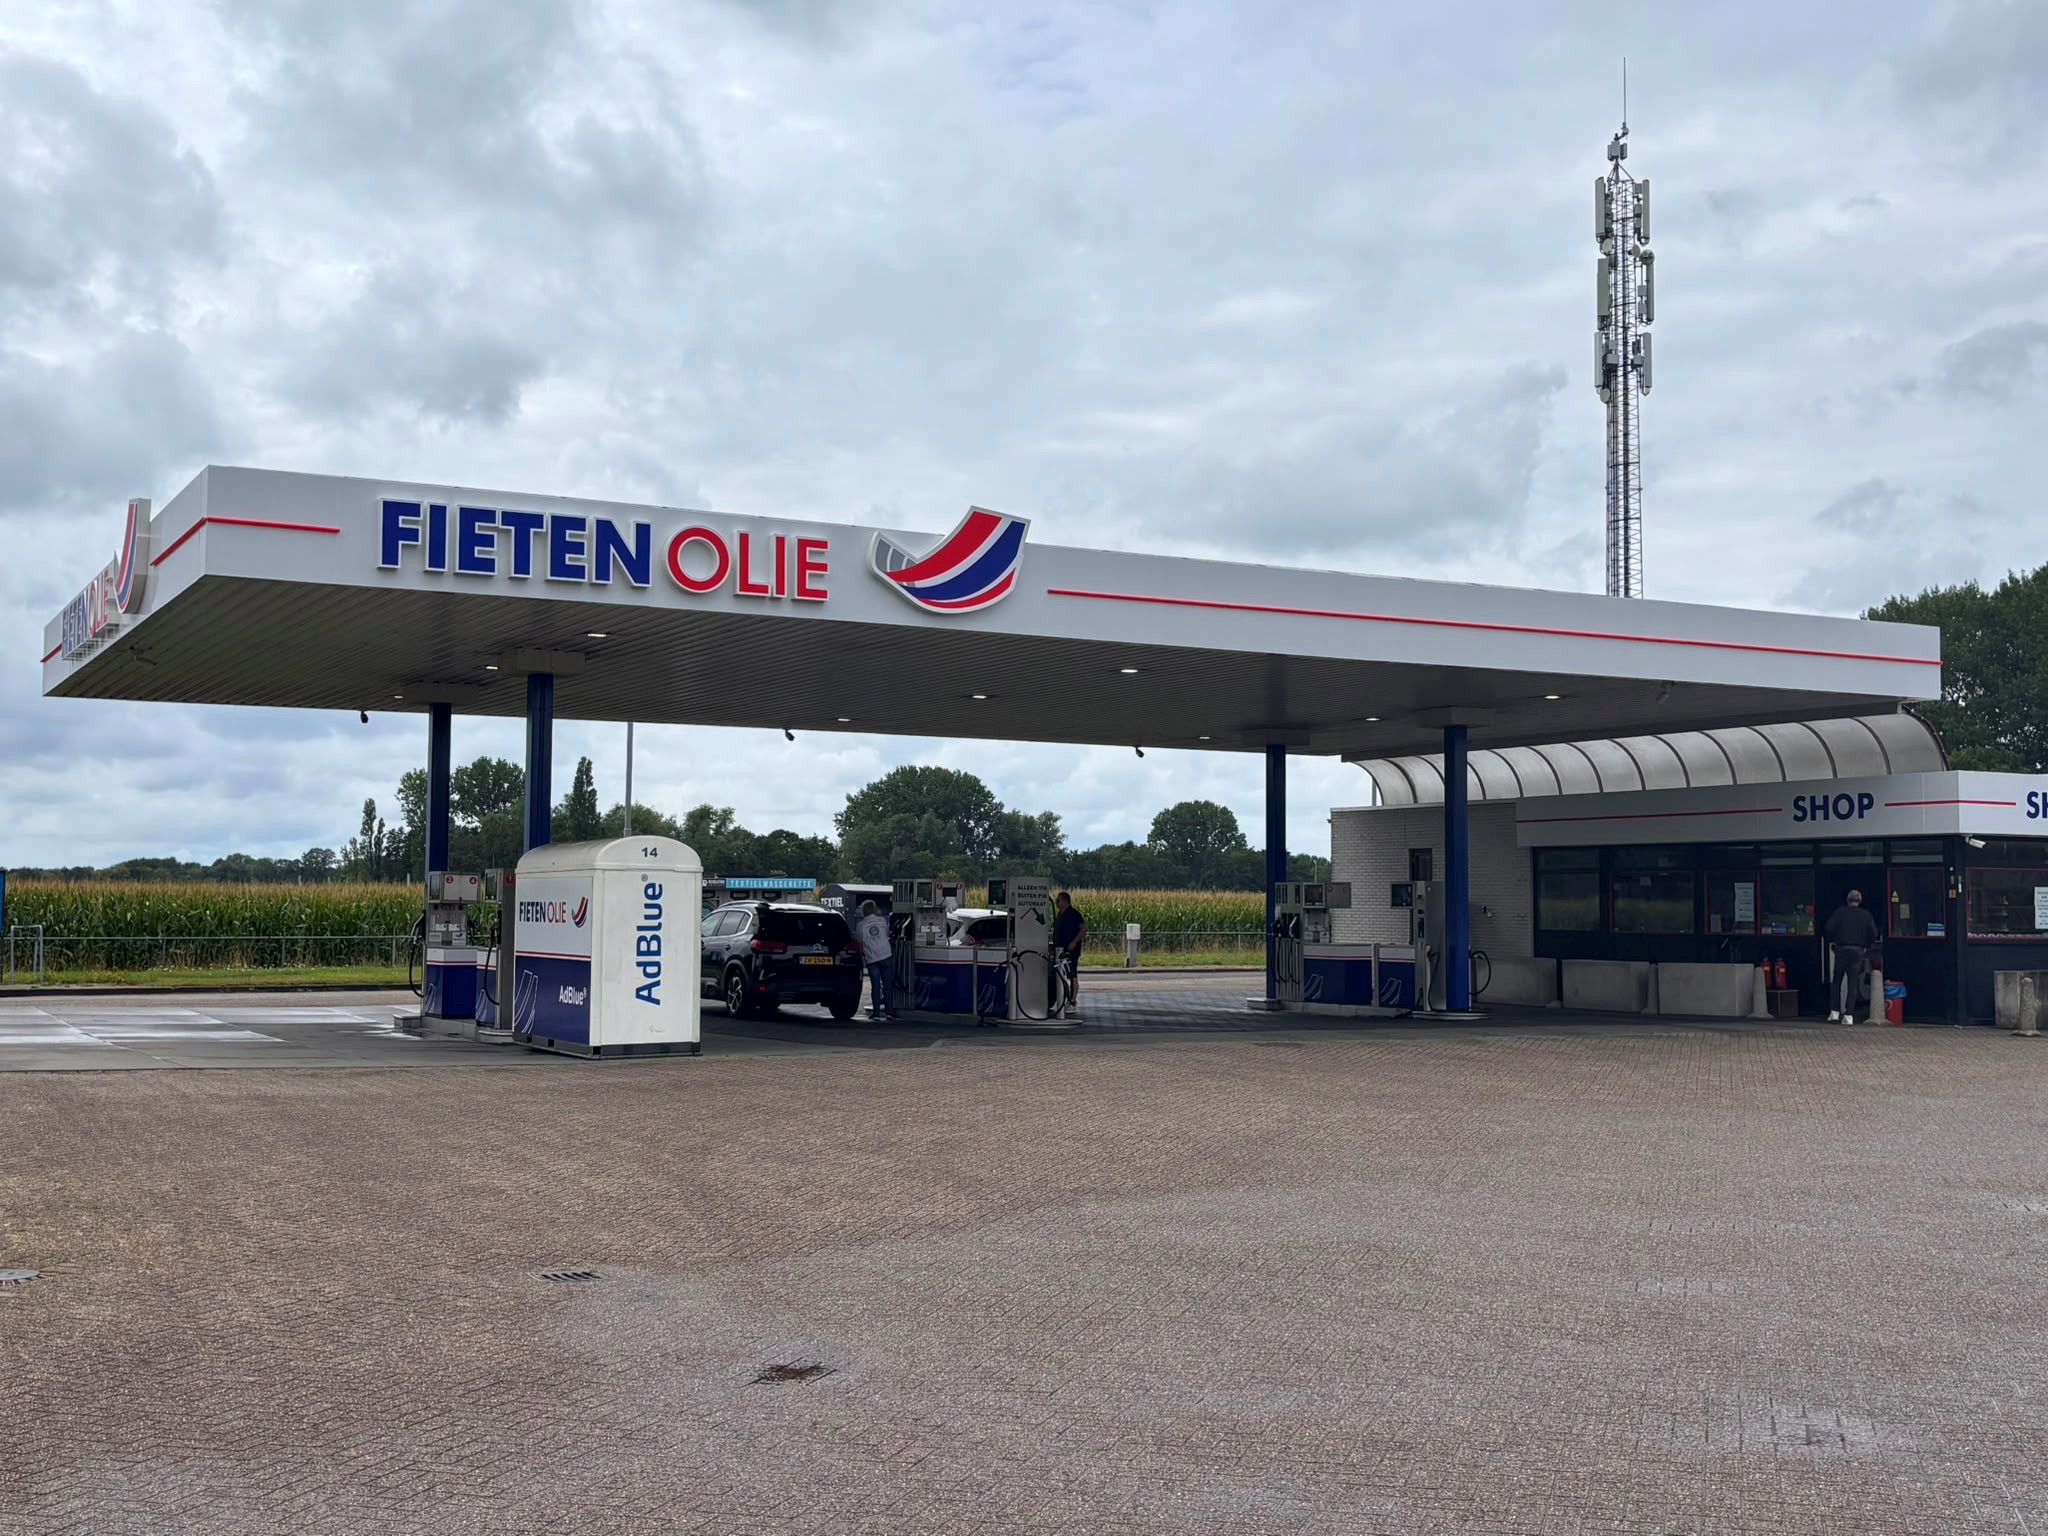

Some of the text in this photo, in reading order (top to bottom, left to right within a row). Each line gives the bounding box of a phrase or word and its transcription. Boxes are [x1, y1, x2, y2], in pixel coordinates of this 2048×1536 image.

[380, 499, 830, 601] FIETEN OLIE
[1792, 792, 1874, 822] SHOP
[641, 847, 658, 858] 14
[519, 901, 566, 924] FIETEN OLIE
[820, 896, 844, 908] TEXTIEL
